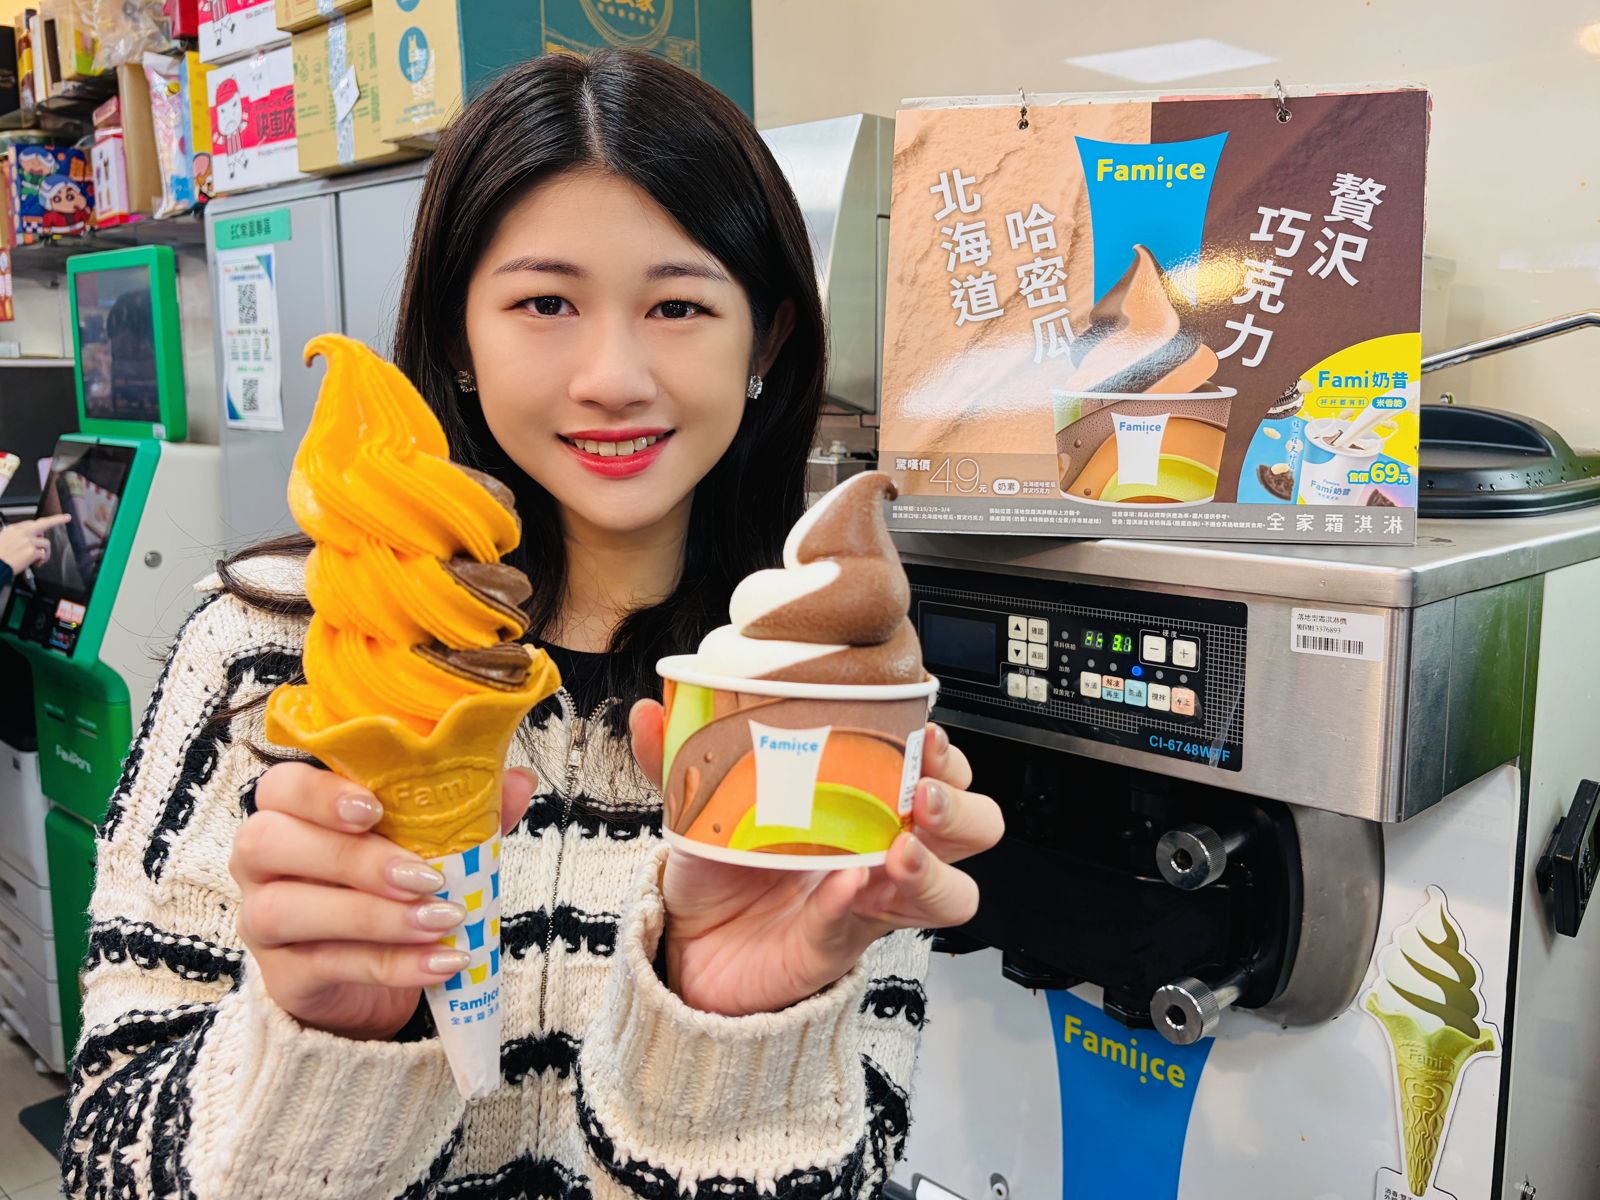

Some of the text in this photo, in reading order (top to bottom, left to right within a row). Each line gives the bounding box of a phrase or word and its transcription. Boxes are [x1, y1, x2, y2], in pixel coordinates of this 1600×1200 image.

[930, 168, 1004, 327] 北海道
[1307, 172, 1386, 286] 贅沢
[1005, 203, 1078, 364] 哈密瓜
[1216, 206, 1312, 368] 巧克力
[930, 457, 980, 494] 49
[978, 484, 988, 493] 元
[998, 482, 1015, 491] 奶素
[1371, 463, 1399, 484] 69
[1399, 474, 1408, 484] 元
[1266, 512, 1403, 534] 全家霜淇淋
[1106, 691, 1120, 699] 再生
